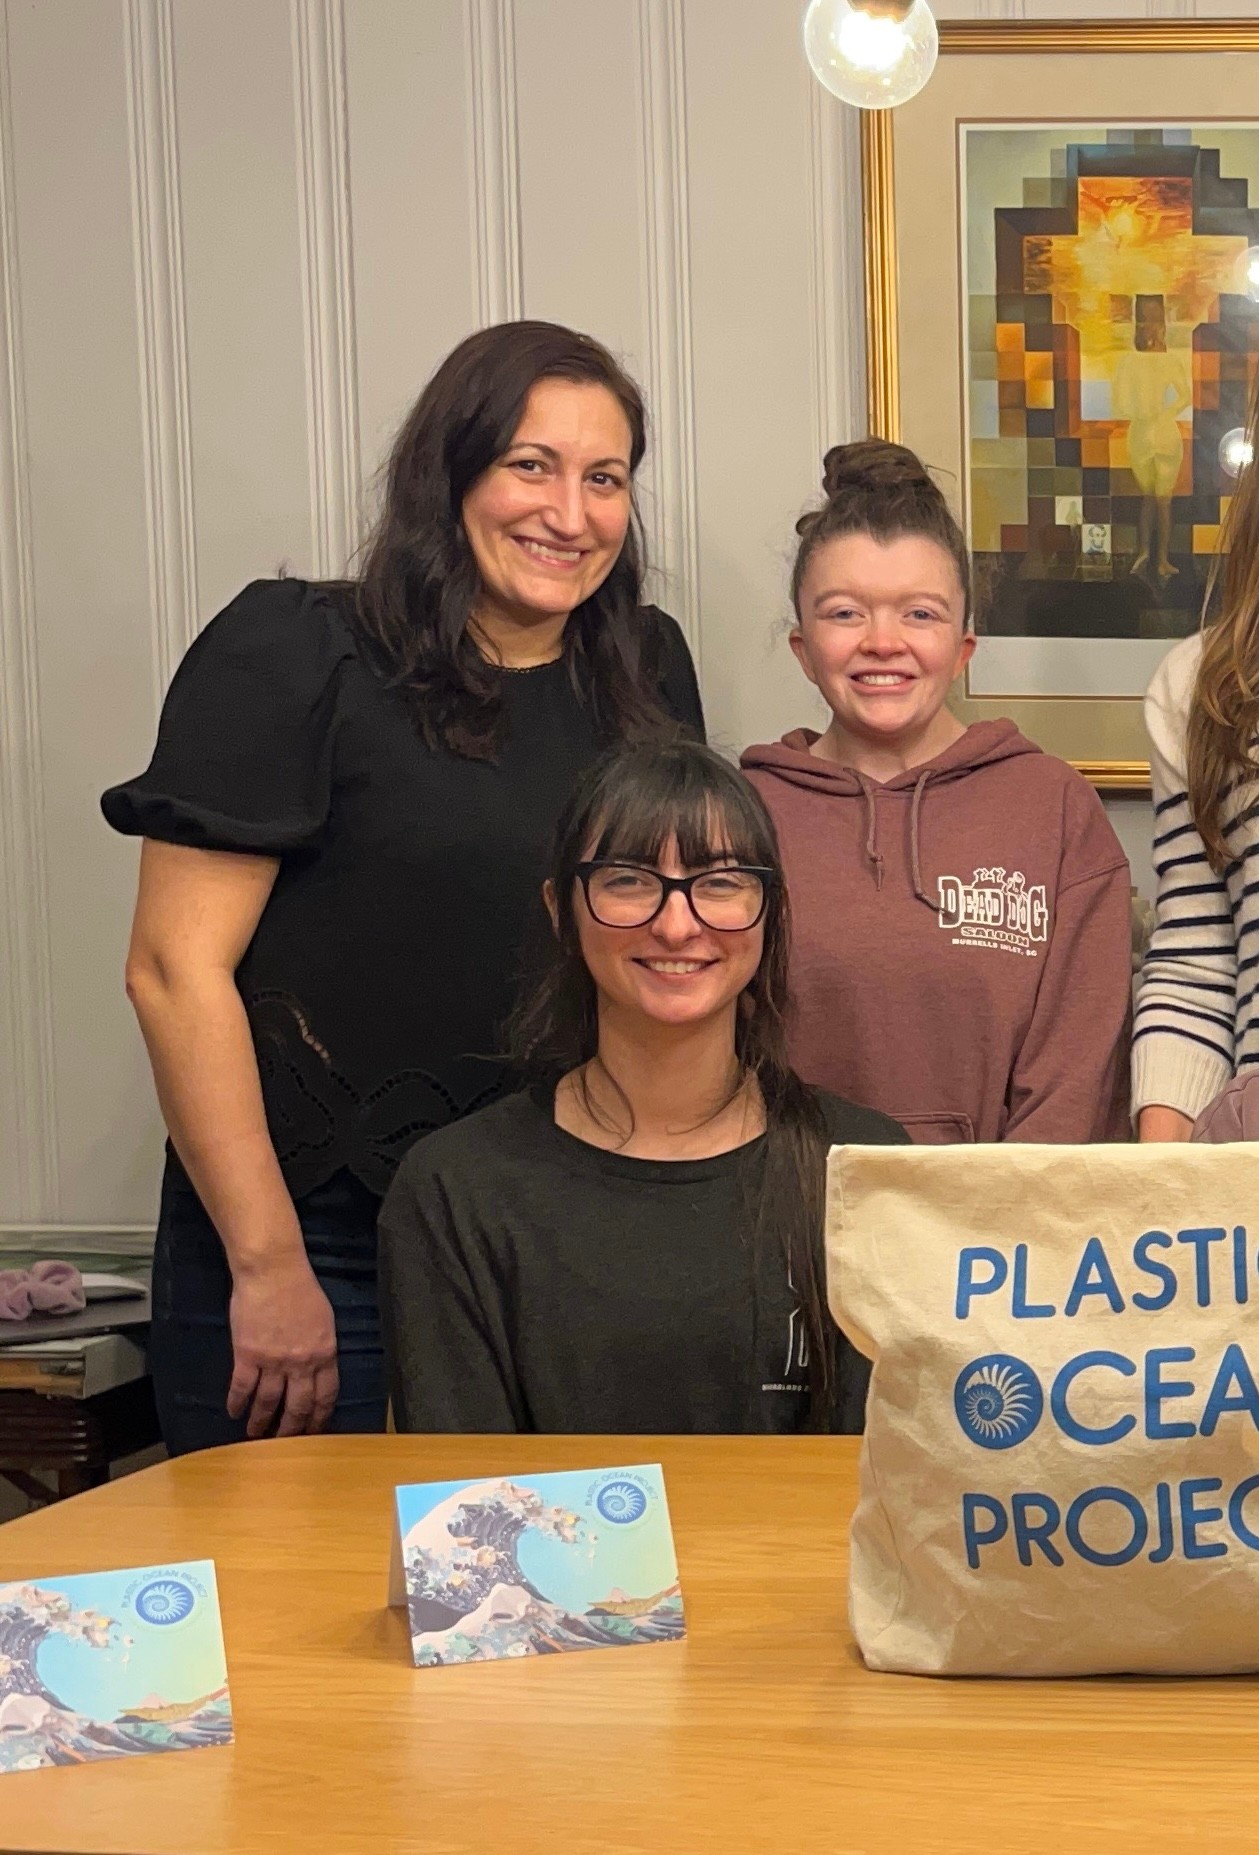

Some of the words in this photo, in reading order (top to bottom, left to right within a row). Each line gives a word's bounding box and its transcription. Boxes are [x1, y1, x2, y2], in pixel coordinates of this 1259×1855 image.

[938, 876, 1004, 928] DEAD
[1007, 885, 1048, 942] DOG
[952, 938, 998, 948] MURRELLS
[961, 926, 1029, 948] SALOON
[585, 1480, 601, 1506] PLASTIC
[601, 1472, 632, 1481] OCEAN
[634, 1474, 658, 1499] PROJECT
[143, 1570, 179, 1581] OCEAN
